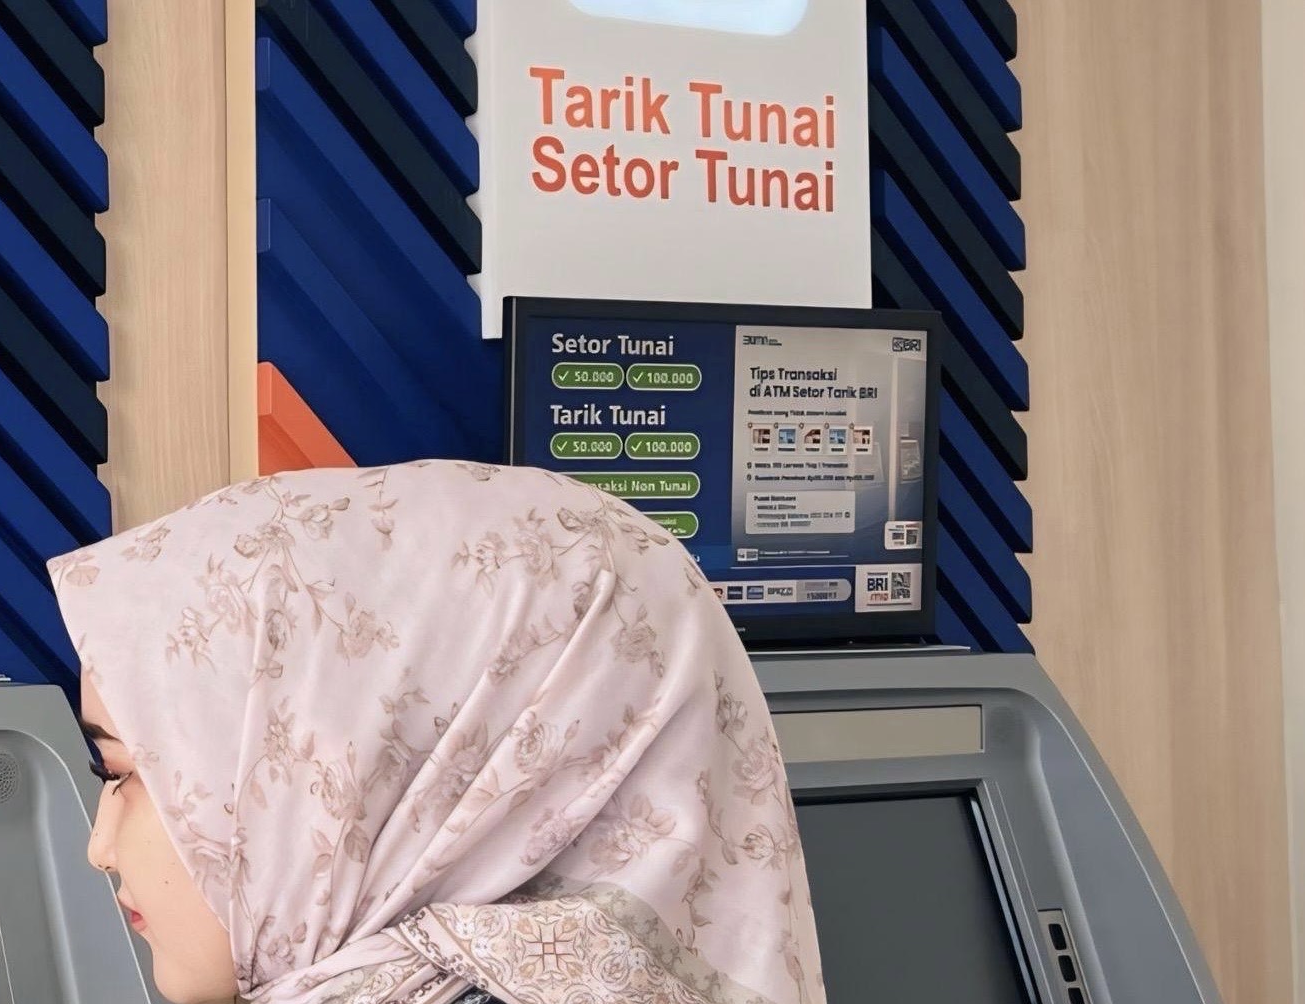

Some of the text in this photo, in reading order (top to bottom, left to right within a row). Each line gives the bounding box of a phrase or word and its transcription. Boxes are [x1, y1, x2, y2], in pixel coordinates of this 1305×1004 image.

[529, 66, 835, 149] Tarik Tunai
[531, 136, 835, 213] Setor Tunai
[551, 332, 675, 356] Setor Tunai
[574, 370, 694, 385] 50.000 100.000
[749, 366, 838, 383] Tips Transaksi
[749, 383, 762, 398] di
[764, 385, 791, 397] ATM
[793, 386, 825, 399] Setor
[828, 386, 857, 399] Tarik
[550, 403, 666, 426] Tarik Tunai
[572, 440, 692, 453] 50.000 100.000
[596, 479, 692, 493] saksi Non Tunai
[867, 577, 889, 592] BRI
